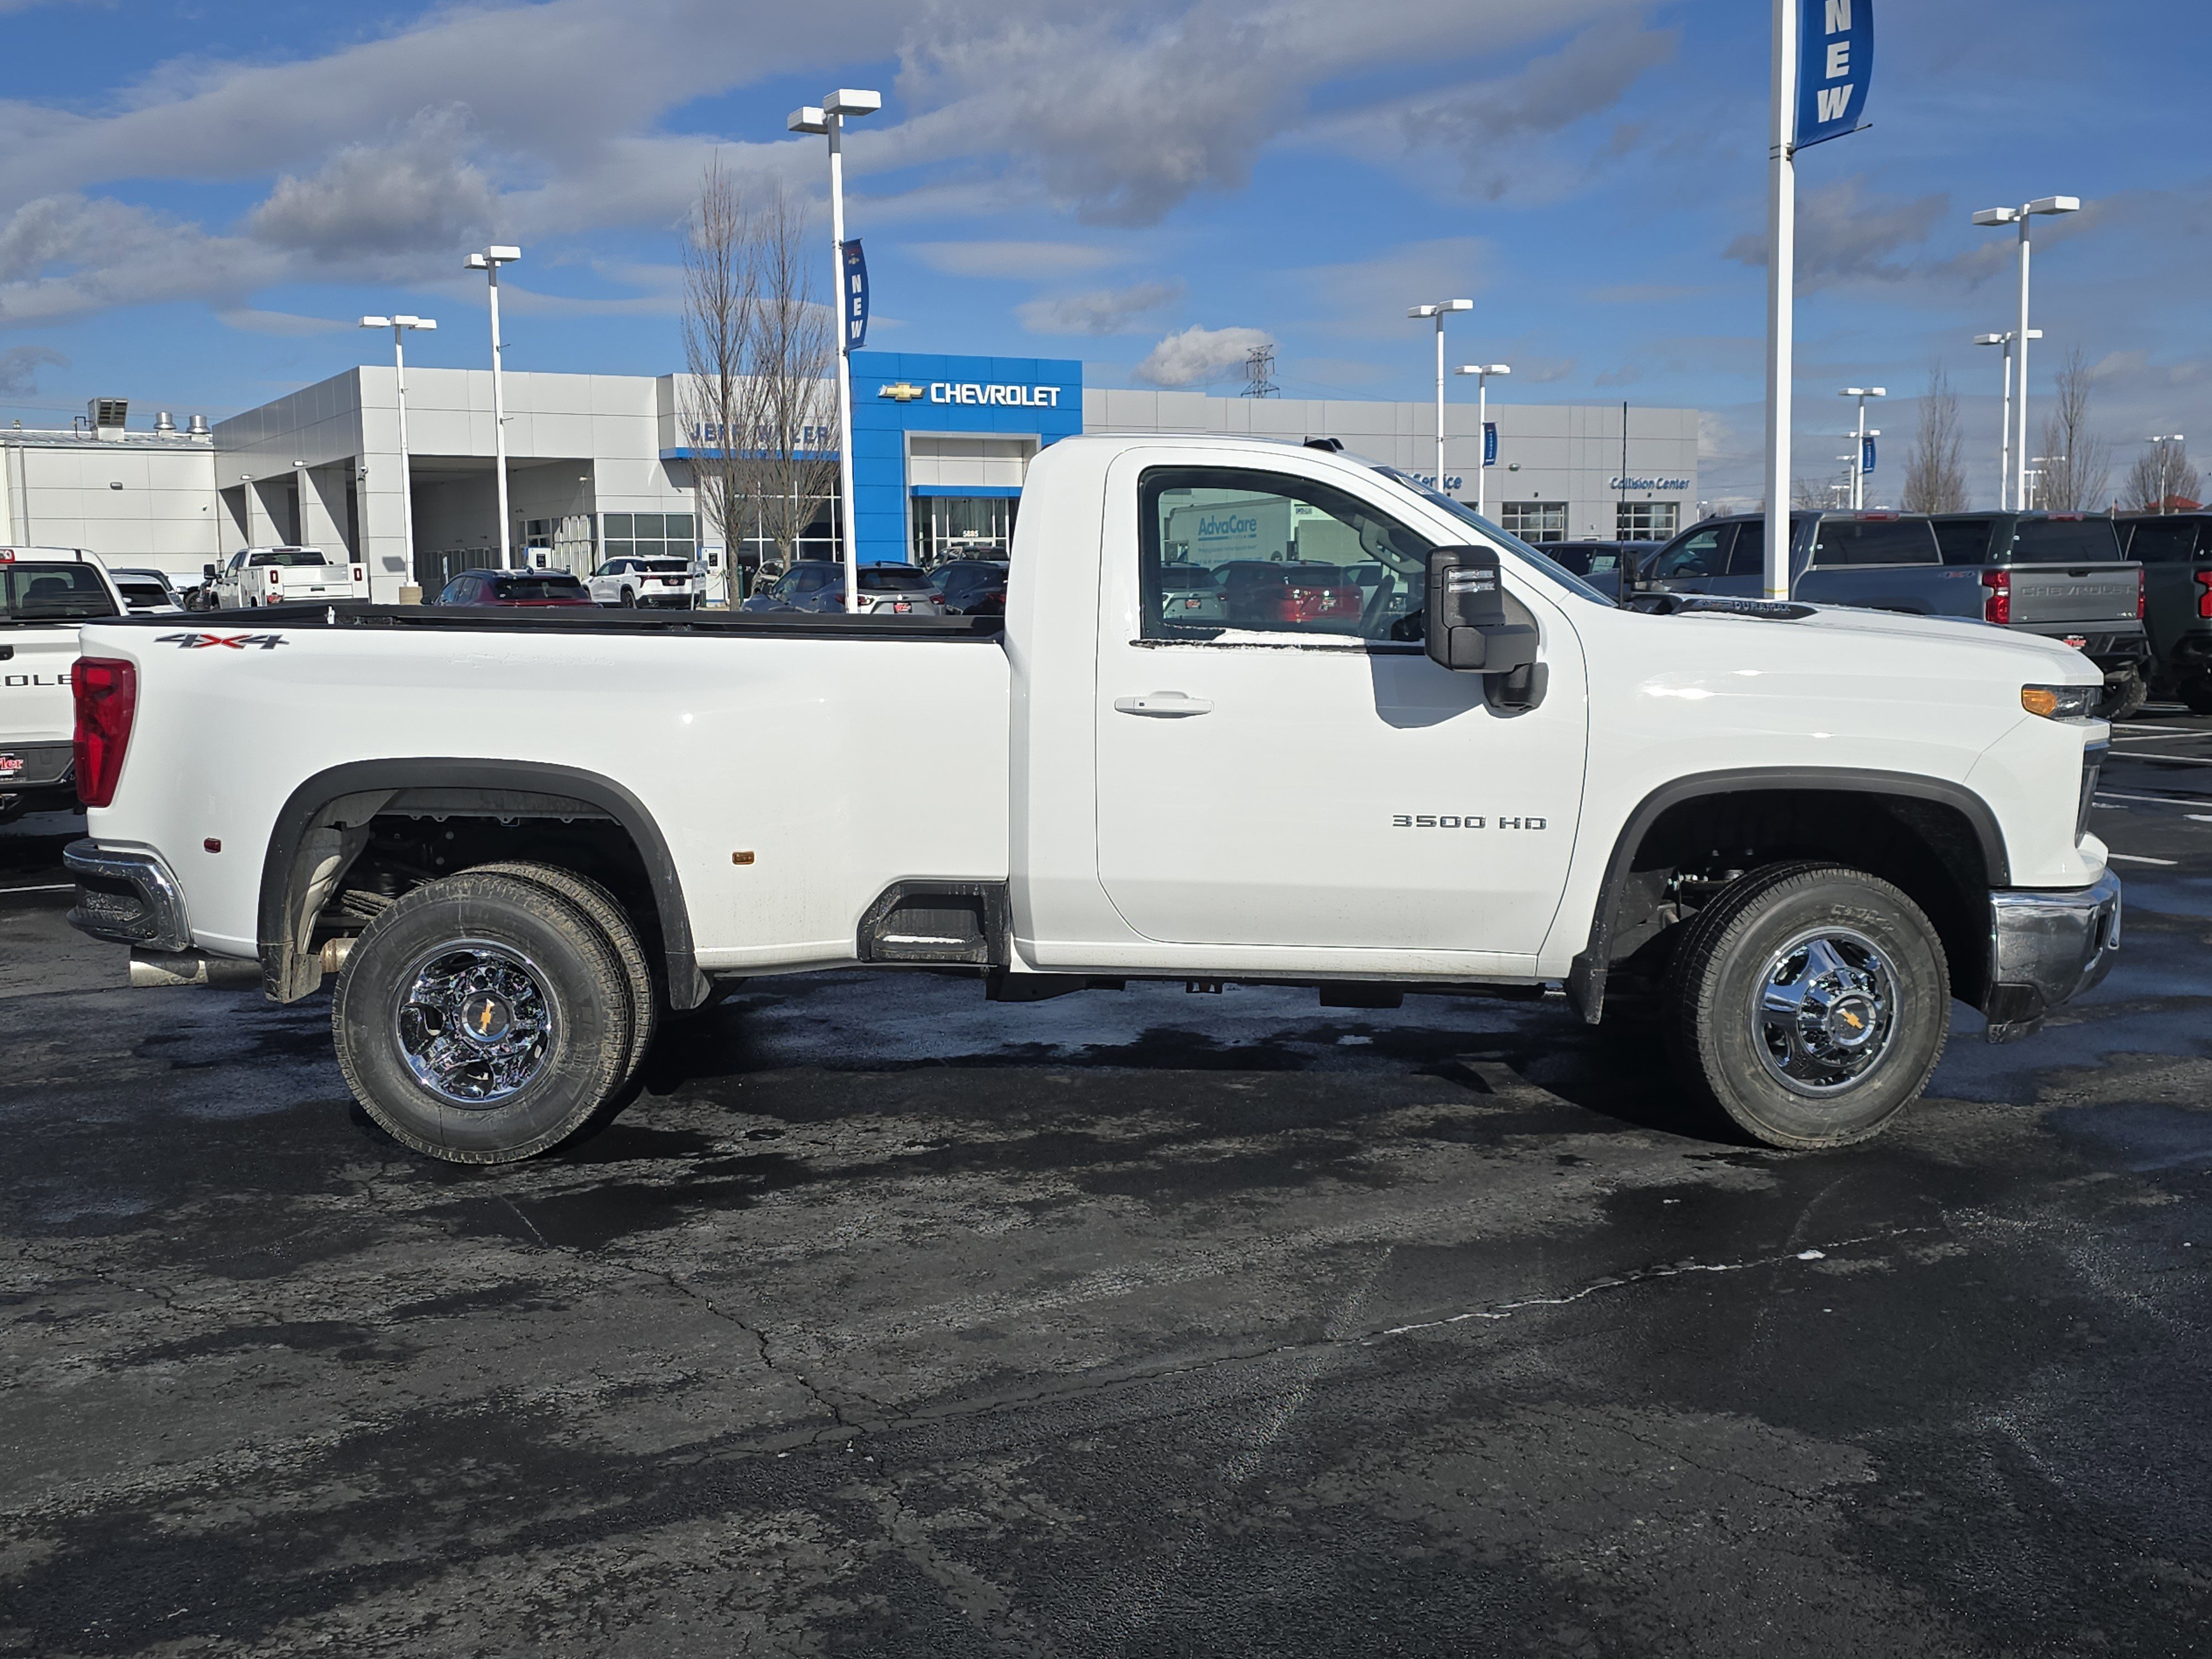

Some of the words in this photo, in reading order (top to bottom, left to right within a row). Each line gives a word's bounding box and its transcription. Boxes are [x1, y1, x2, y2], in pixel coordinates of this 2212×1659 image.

[1817, 0, 1854, 123] NEW
[851, 274, 863, 339] NEW
[931, 383, 1061, 406] CHEVROLET
[757, 424, 828, 443] WLER
[1610, 477, 1655, 489] Collision
[1656, 477, 1690, 489] Center
[1198, 514, 1257, 535] AdvaCare
[1392, 815, 1486, 828] 3500
[1499, 817, 1547, 830] HD
